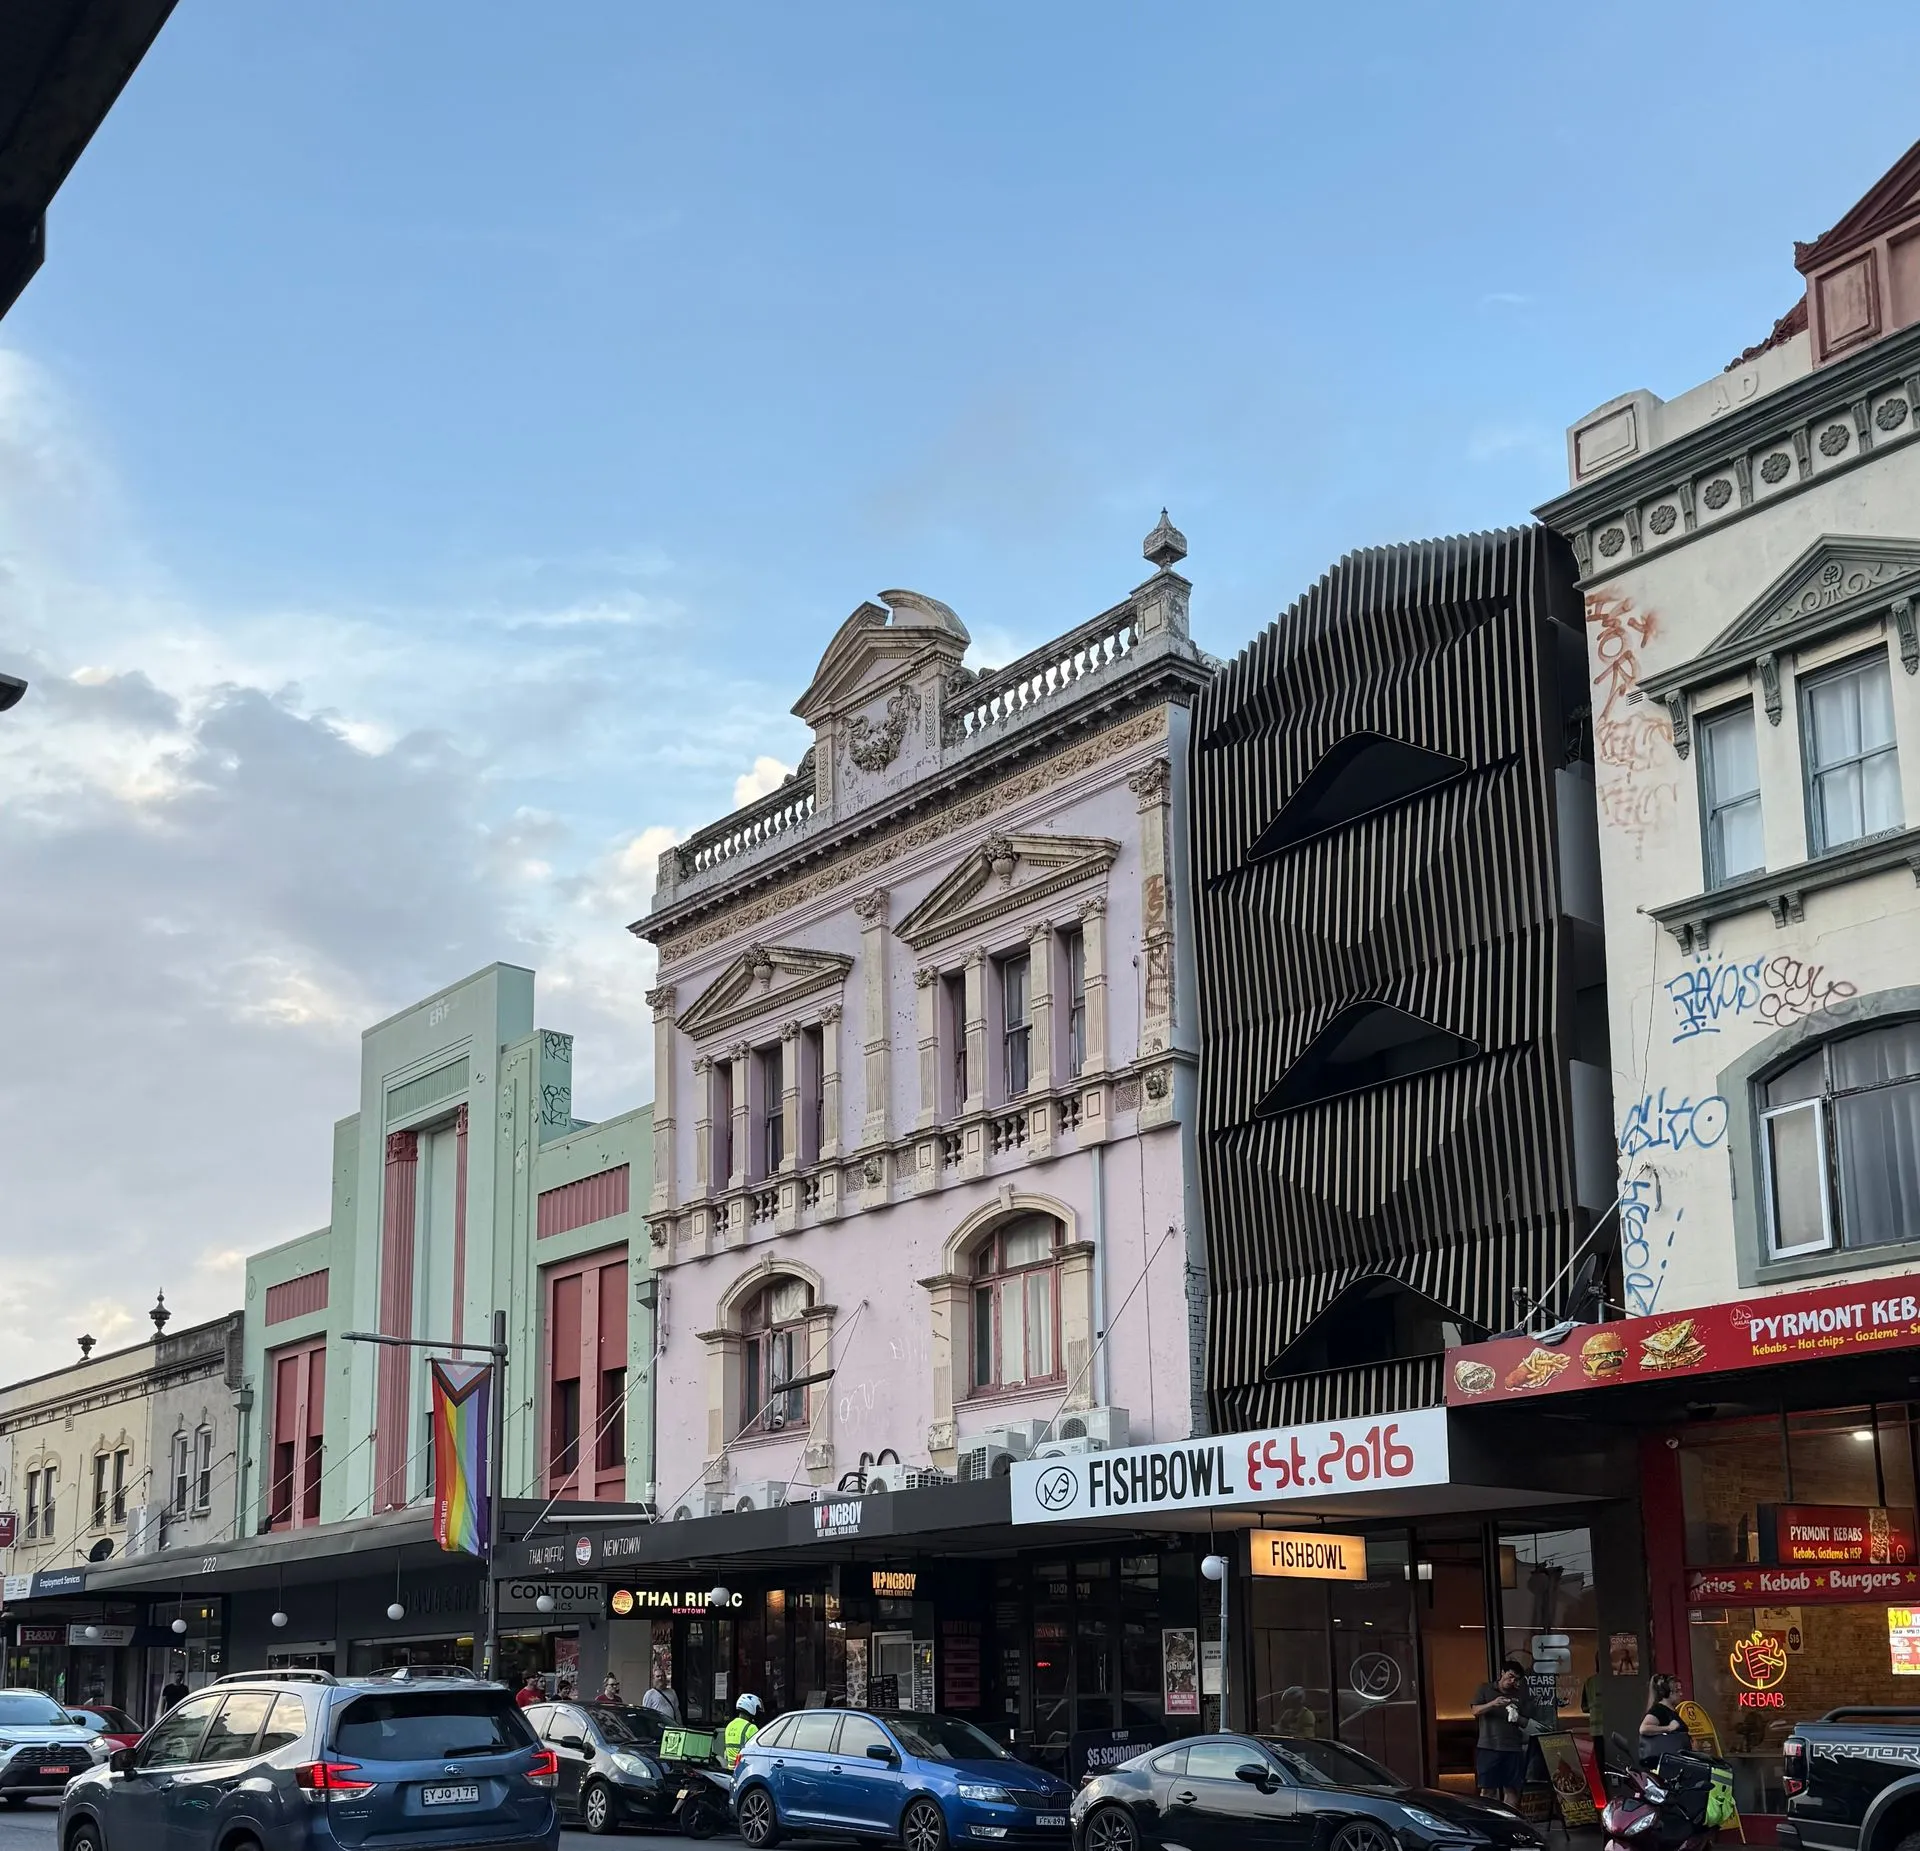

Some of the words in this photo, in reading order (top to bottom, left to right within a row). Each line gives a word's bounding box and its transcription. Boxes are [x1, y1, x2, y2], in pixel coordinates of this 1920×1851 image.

[1750, 1303, 1867, 1342] PYRMONT
[1871, 1296, 1920, 1326] KEB
[1752, 1343, 1788, 1356] Kebabs
[1798, 1338, 1815, 1350] Hot
[1818, 1335, 1844, 1350] chips
[1855, 1328, 1899, 1342] Gozleme
[1089, 1446, 1234, 1508] FISHBOWL
[1790, 1525, 1830, 1541] PYRMONT
[1833, 1527, 1863, 1542] KEBABS
[529, 1549, 543, 1565] THAI
[603, 1536, 641, 1557] NEWTOWN
[1272, 1540, 1347, 1571] FISHBOWL
[1793, 1546, 1818, 1560] Kebabs,
[1818, 1547, 1843, 1560] Gozleme
[1844, 1547, 1849, 1559] &
[1850, 1547, 1863, 1559] HSP
[202, 1556, 217, 1573] 222
[40, 1577, 63, 1588] Employment
[64, 1575, 81, 1585] Services
[1760, 1572, 1810, 1591] Kebab
[1830, 1570, 1901, 1593] Burgers
[511, 1585, 598, 1600] CONTOUR
[636, 1591, 678, 1607] THAI
[685, 1592, 743, 1607] RIFC
[1889, 1609, 1911, 1628] $10
[25, 1630, 56, 1641] R&W
[1525, 1675, 1555, 1685] YEARS
[1739, 1692, 1785, 1707] KEBAB
[1087, 1748, 1100, 1768] $5
[1813, 1743, 1920, 1765] RAPTOR
